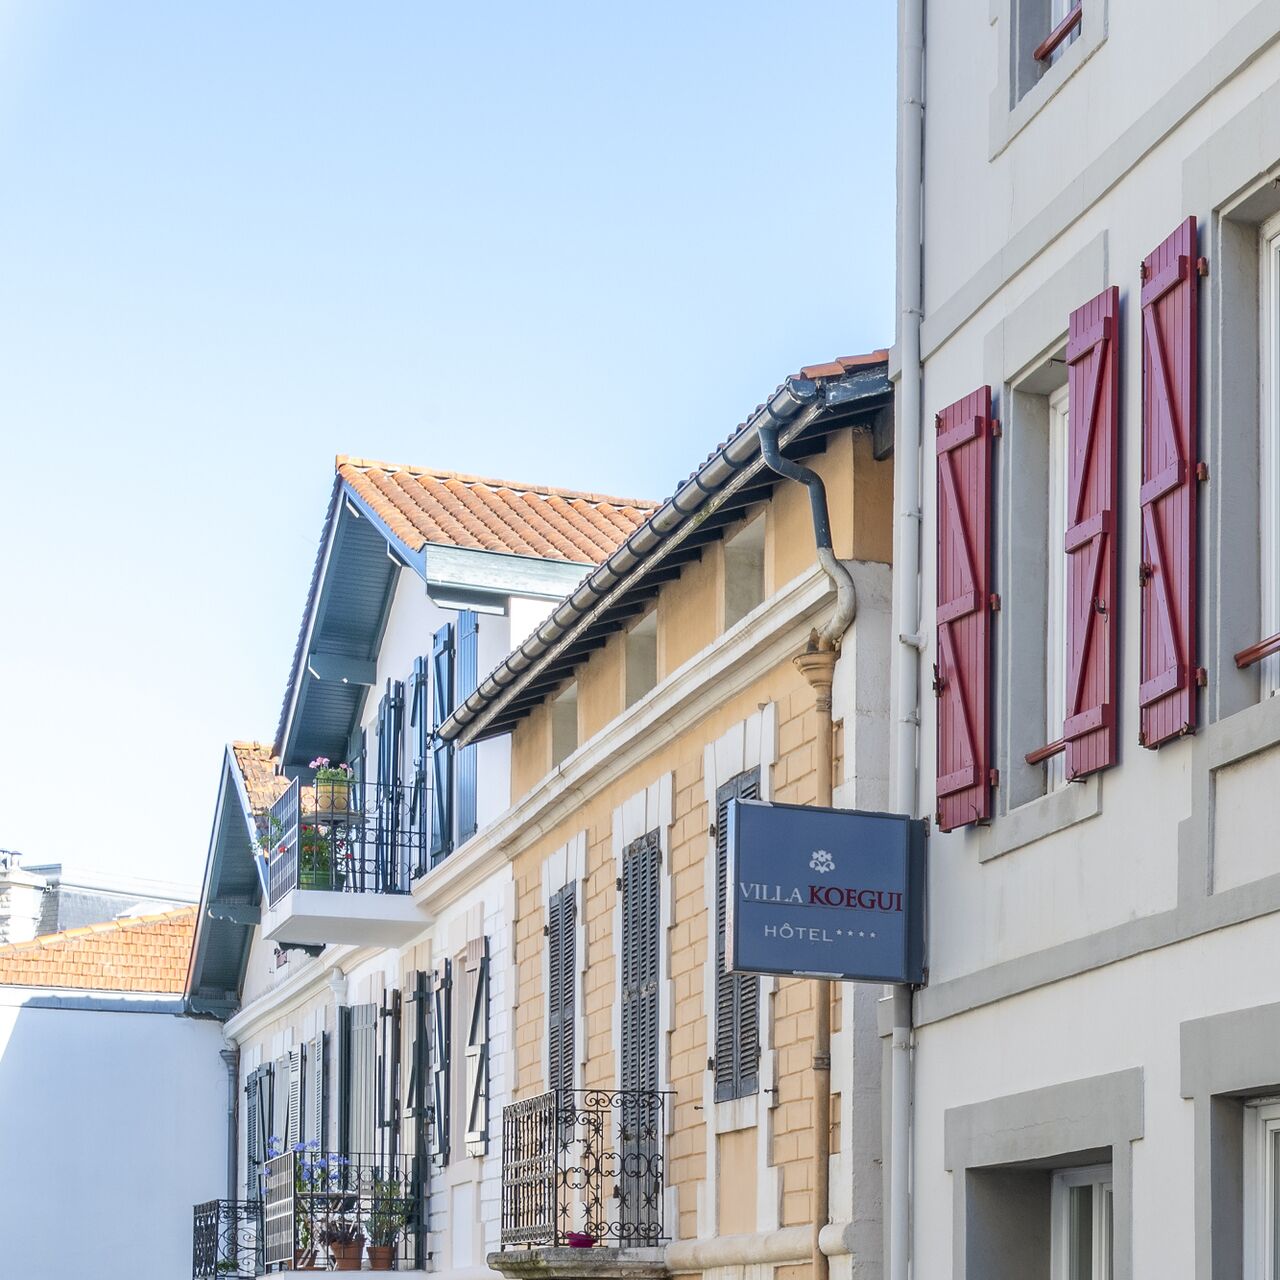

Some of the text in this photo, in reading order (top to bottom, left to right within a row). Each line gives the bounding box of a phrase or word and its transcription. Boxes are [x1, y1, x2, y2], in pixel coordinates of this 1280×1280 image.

[739, 882, 903, 912] VILLA KOEGUI
[764, 922, 834, 942] HÔTEL
